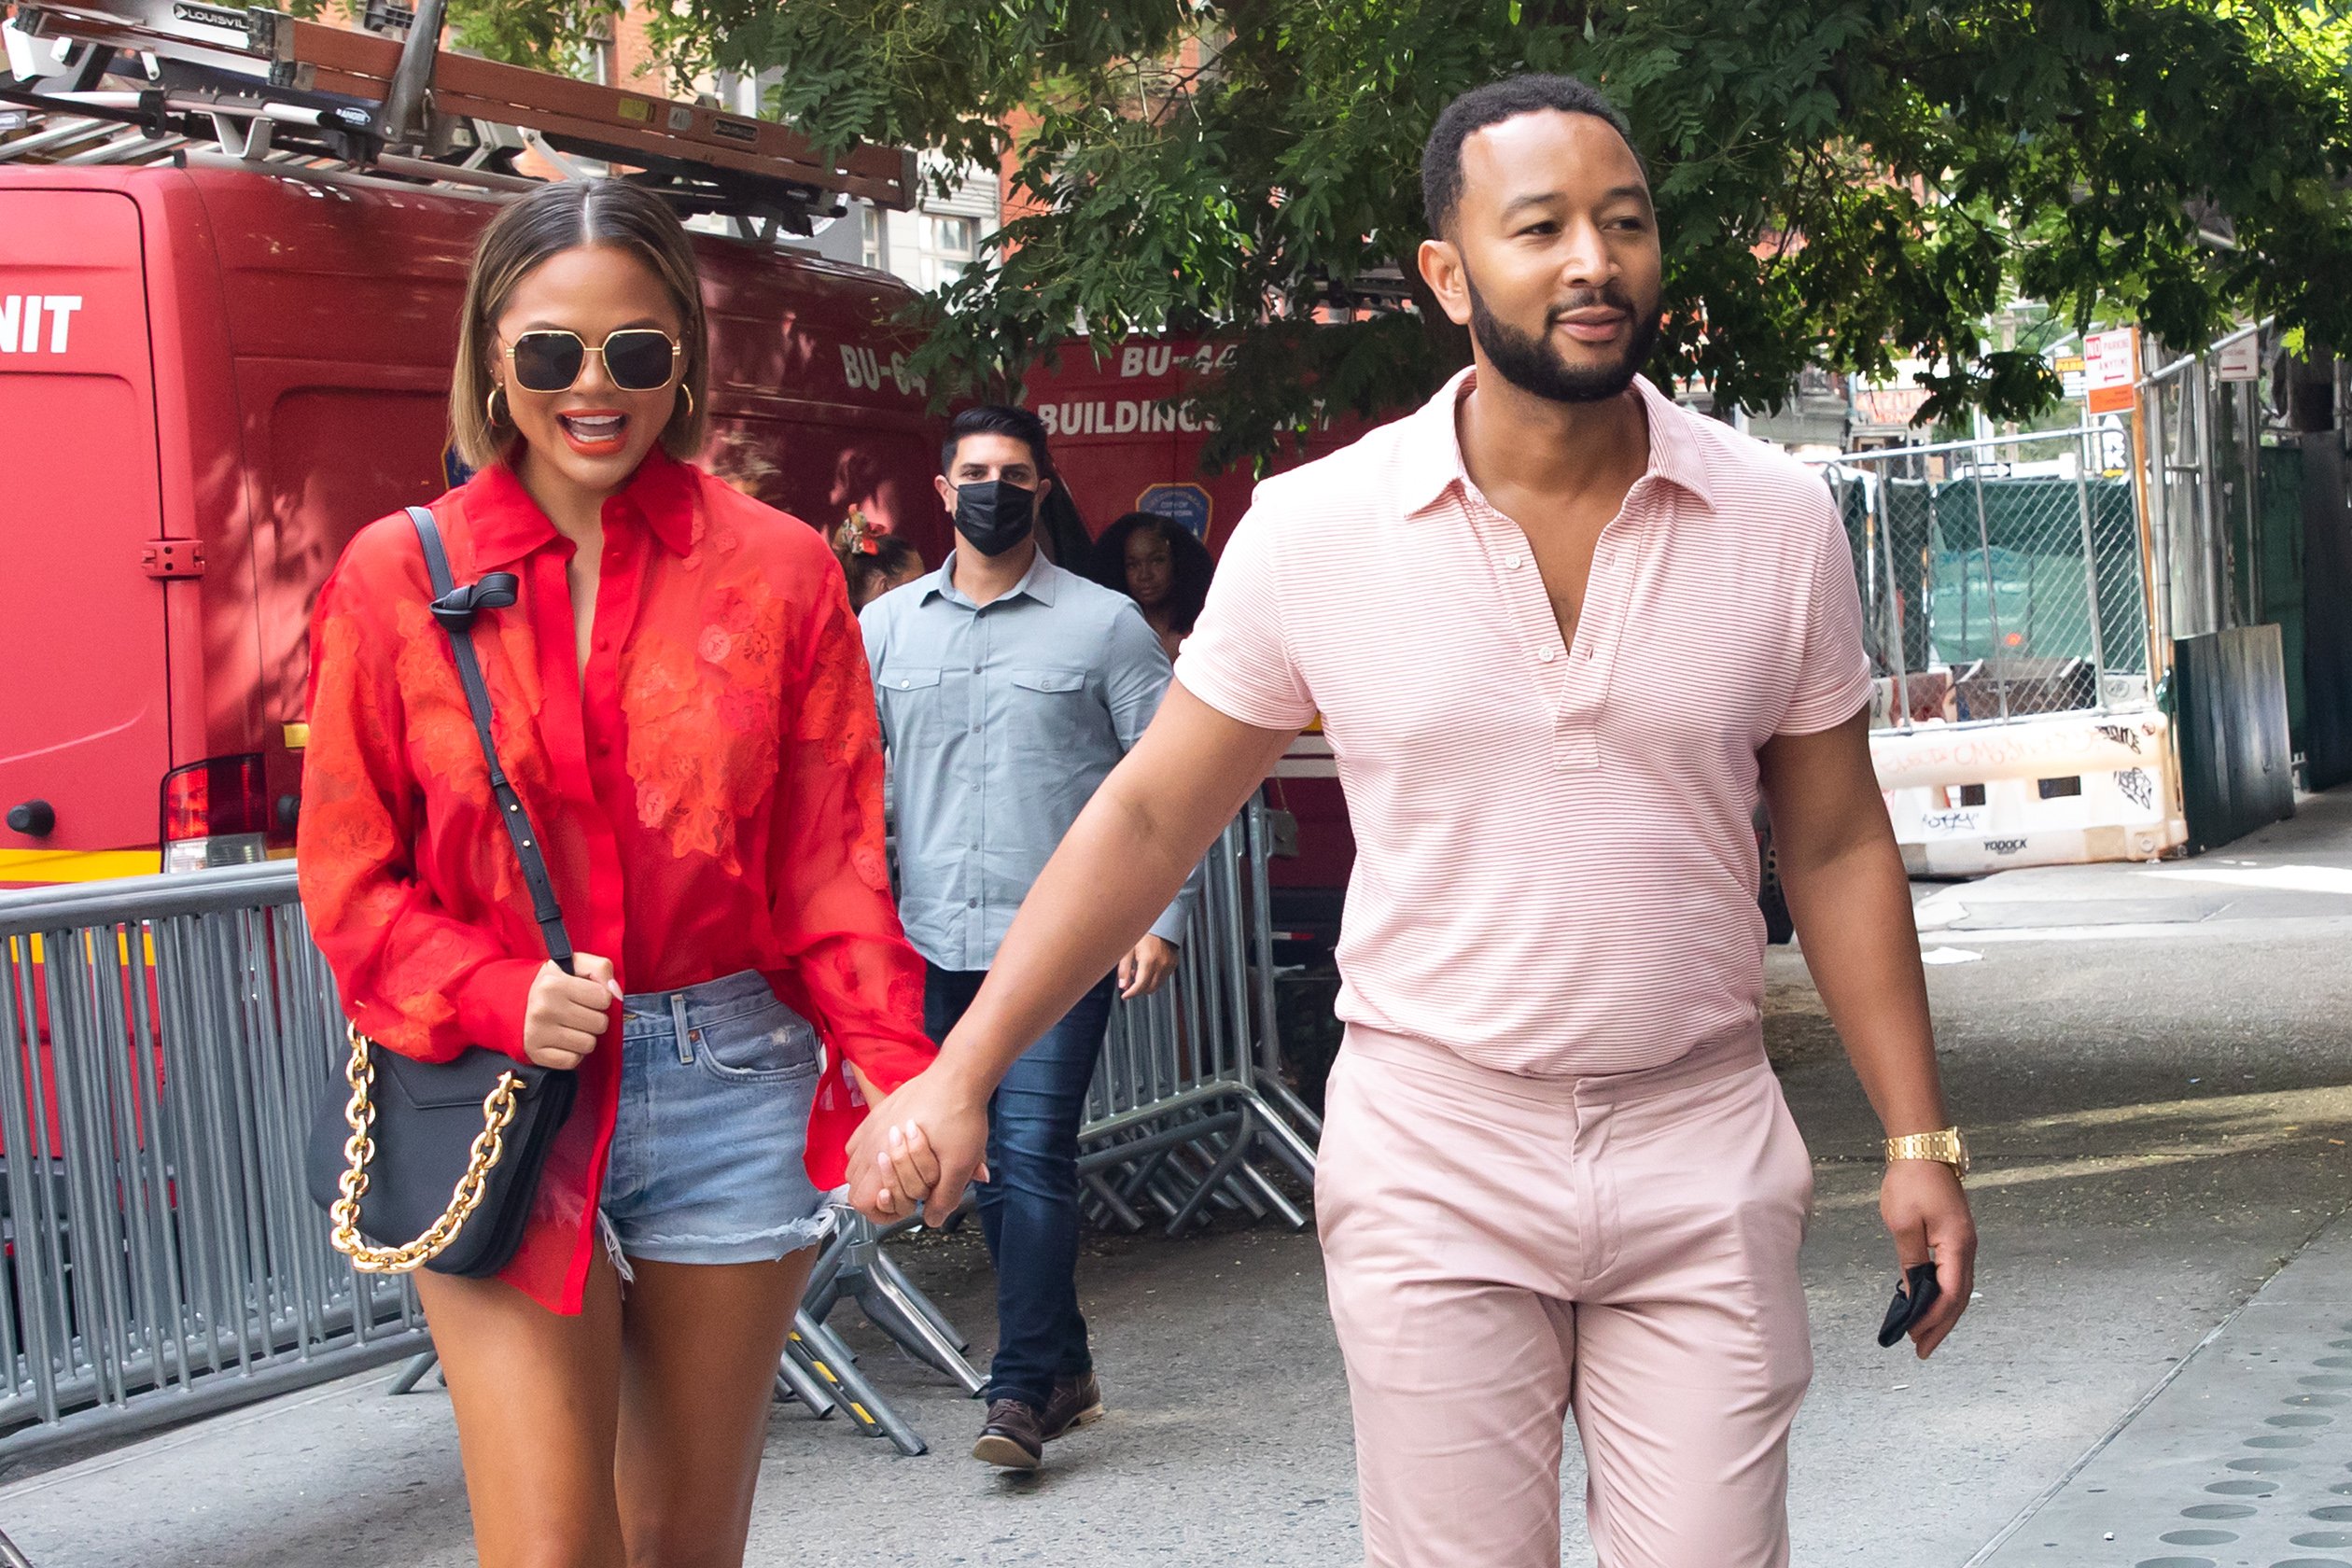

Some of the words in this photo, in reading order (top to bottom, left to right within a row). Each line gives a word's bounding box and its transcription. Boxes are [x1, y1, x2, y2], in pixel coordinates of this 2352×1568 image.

[187, 8, 250, 30] LOUISVIL
[2086, 338, 2101, 359] NO
[1036, 399, 1223, 436] BUILDING
[1983, 838, 2027, 851] YODOCK
